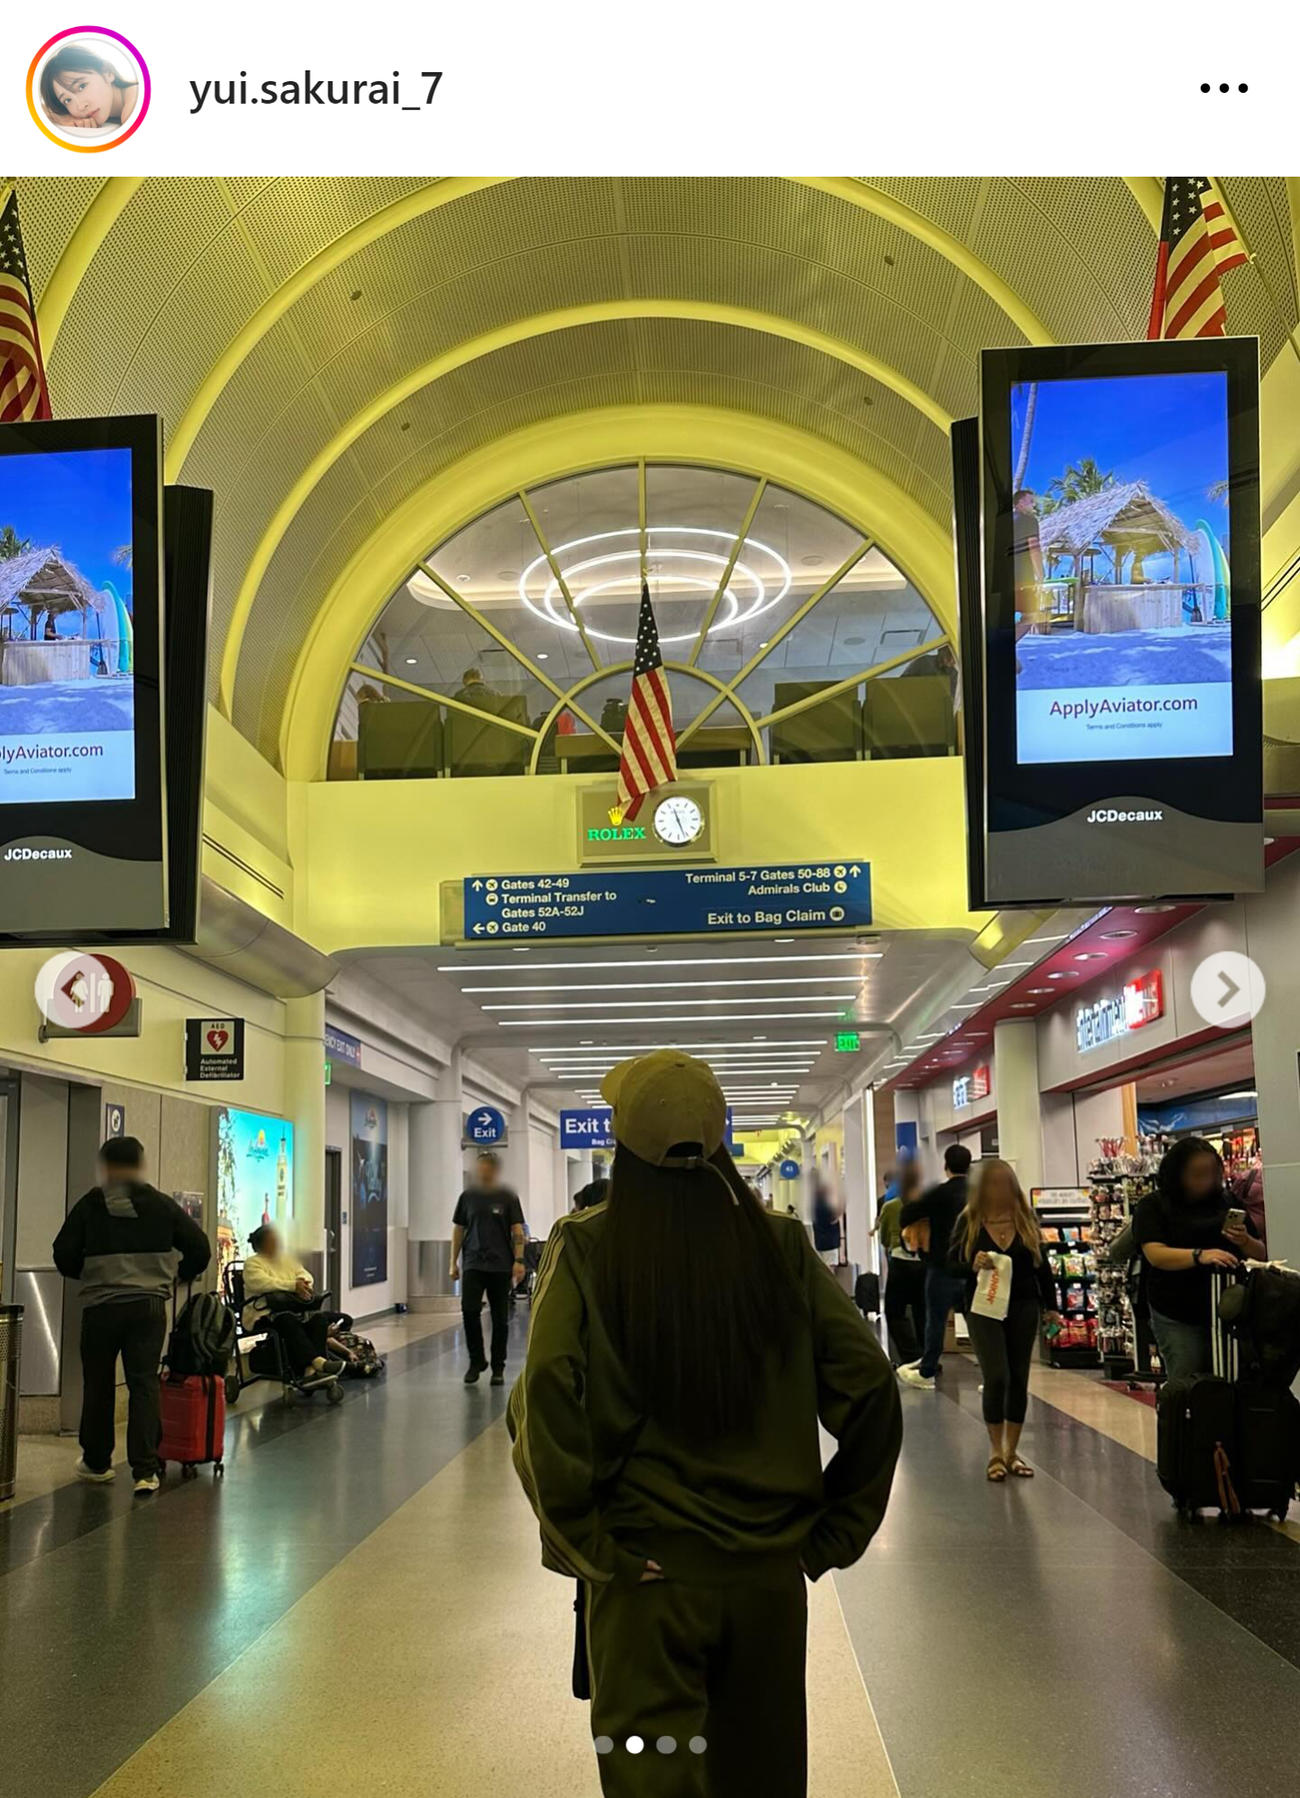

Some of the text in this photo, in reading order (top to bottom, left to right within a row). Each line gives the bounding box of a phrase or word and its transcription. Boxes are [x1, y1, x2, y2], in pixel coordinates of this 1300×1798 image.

[1049, 697, 1198, 719] ApplyAviator.com
[0, 744, 103, 764] lyAviator.com
[1087, 809, 1163, 824] JCDecaux
[587, 826, 646, 841] ROLEX
[4, 848, 72, 861] JCDecaux
[685, 867, 831, 884] Terminal 5-7 Gates 50-88
[501, 878, 570, 890] Gates 42-49
[748, 882, 830, 896] Admirals Club
[501, 891, 617, 905] Terminal Transfer to
[501, 906, 585, 918] Gates 52A-52J
[707, 909, 826, 925] Exit to Bag Claim
[502, 921, 546, 933] Gate 40
[474, 1127, 497, 1138] Exit
[565, 1118, 612, 1134] Exit t
[591, 1138, 605, 1146] Bag
